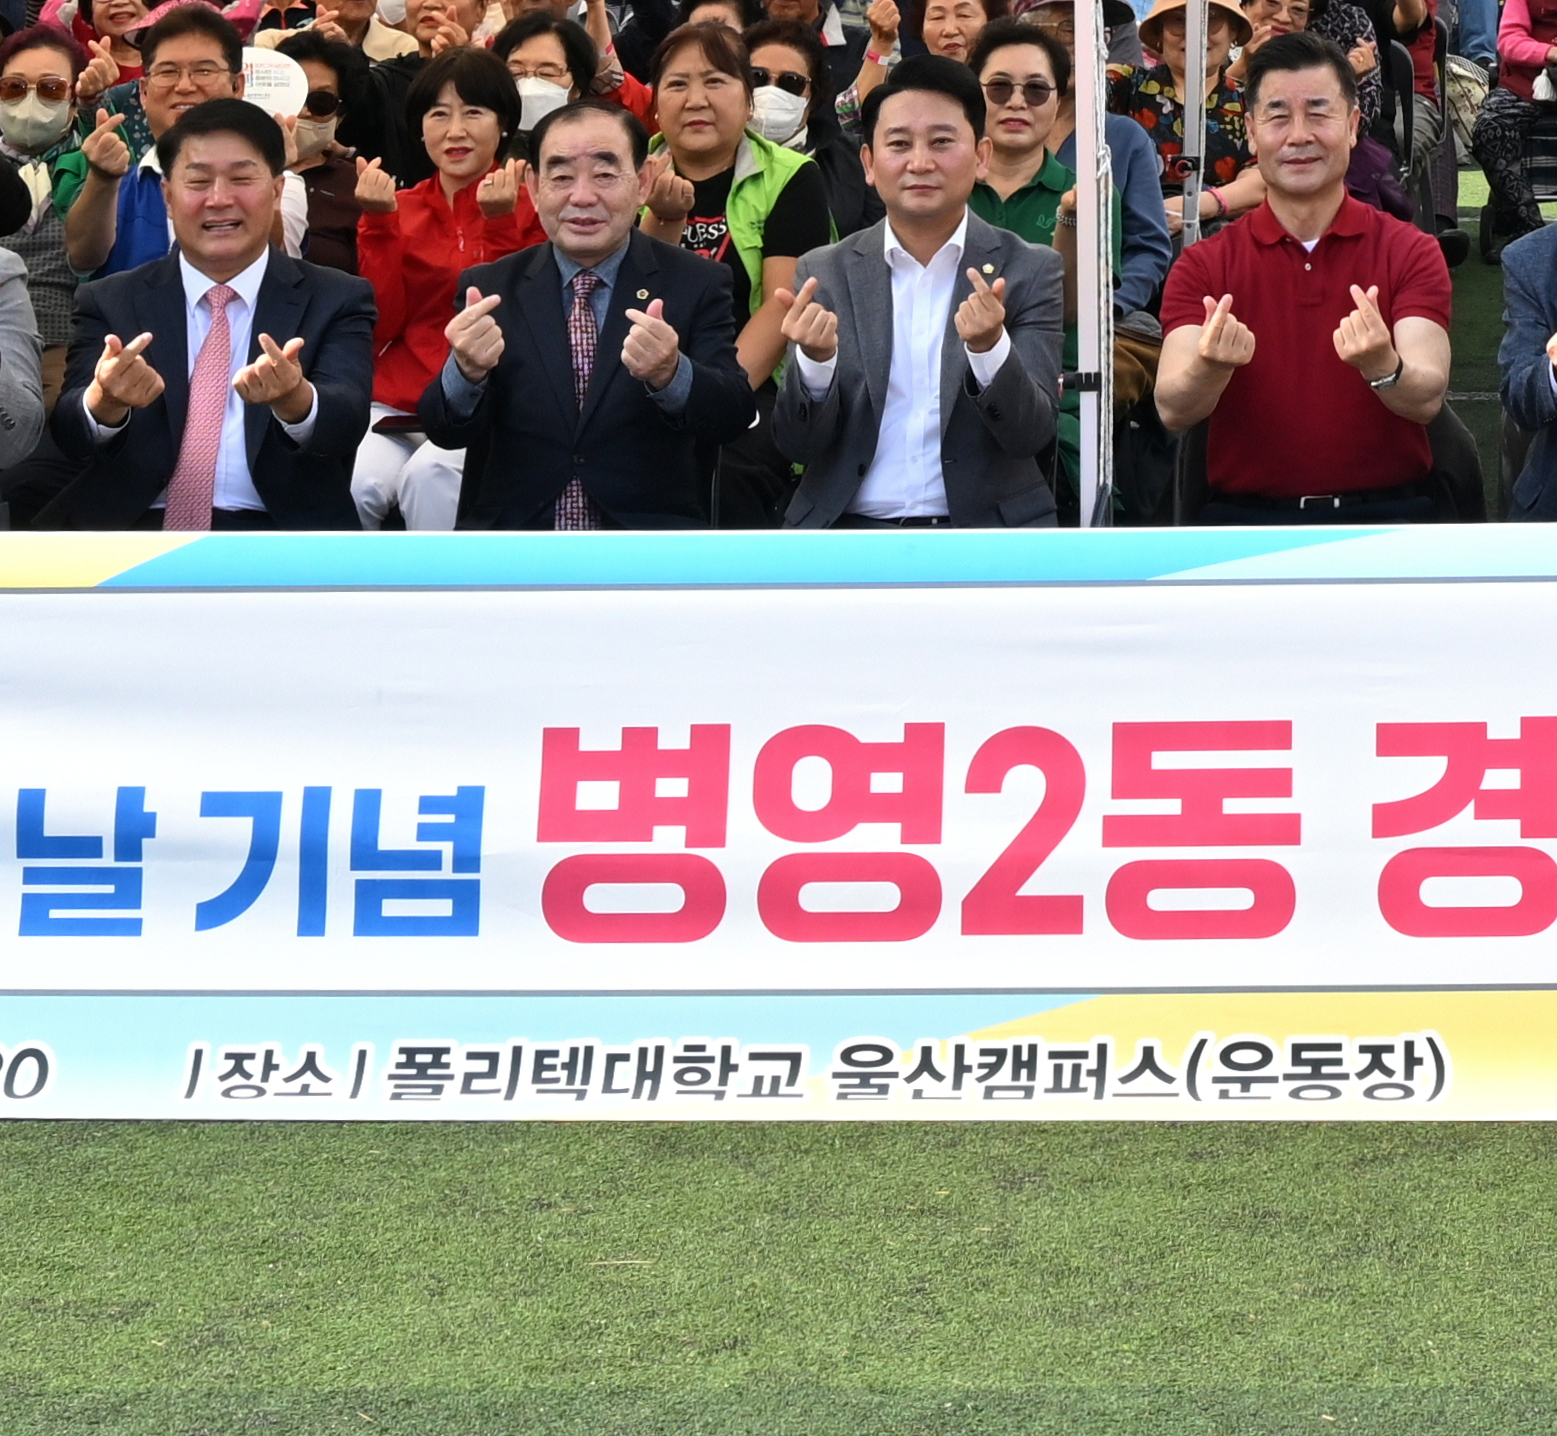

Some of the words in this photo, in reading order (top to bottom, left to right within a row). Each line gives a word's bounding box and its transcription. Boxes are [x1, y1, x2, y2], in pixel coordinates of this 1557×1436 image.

[682, 219, 728, 244] UESS
[195, 785, 486, 938] 기념
[537, 719, 1302, 943] 병영2동
[387, 1044, 804, 1101] 폴리텍대학교
[831, 1036, 1446, 1102] 울산캠퍼스(운동장)
